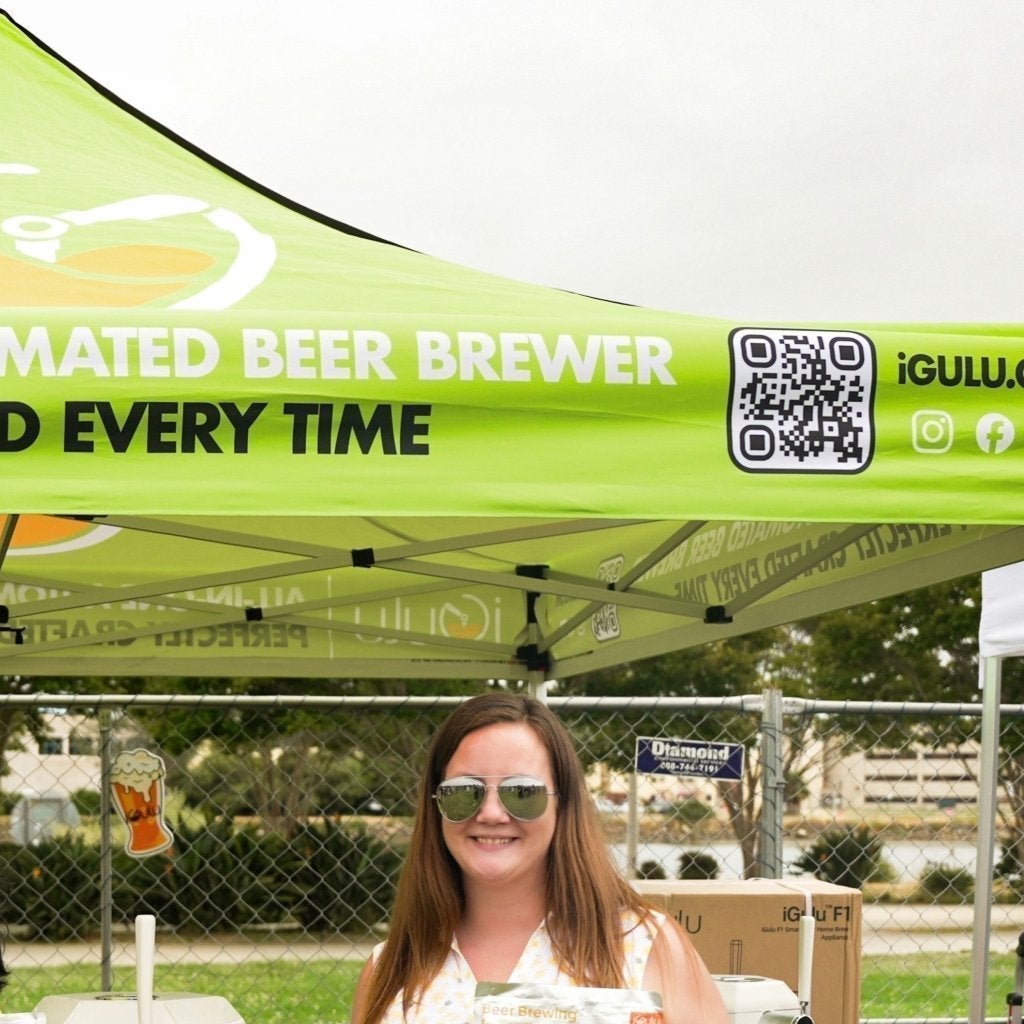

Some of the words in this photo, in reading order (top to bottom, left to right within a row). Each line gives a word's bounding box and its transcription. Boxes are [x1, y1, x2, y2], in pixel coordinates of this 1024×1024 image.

[243, 328, 397, 381] BEER
[416, 330, 677, 385] BREWER
[63, 401, 269, 455] EVERY
[283, 402, 432, 456] TIME
[651, 740, 730, 761] Diamond
[833, 906, 851, 922] F1
[482, 1003, 516, 1017] Beer
[518, 1006, 577, 1022] Brewing
